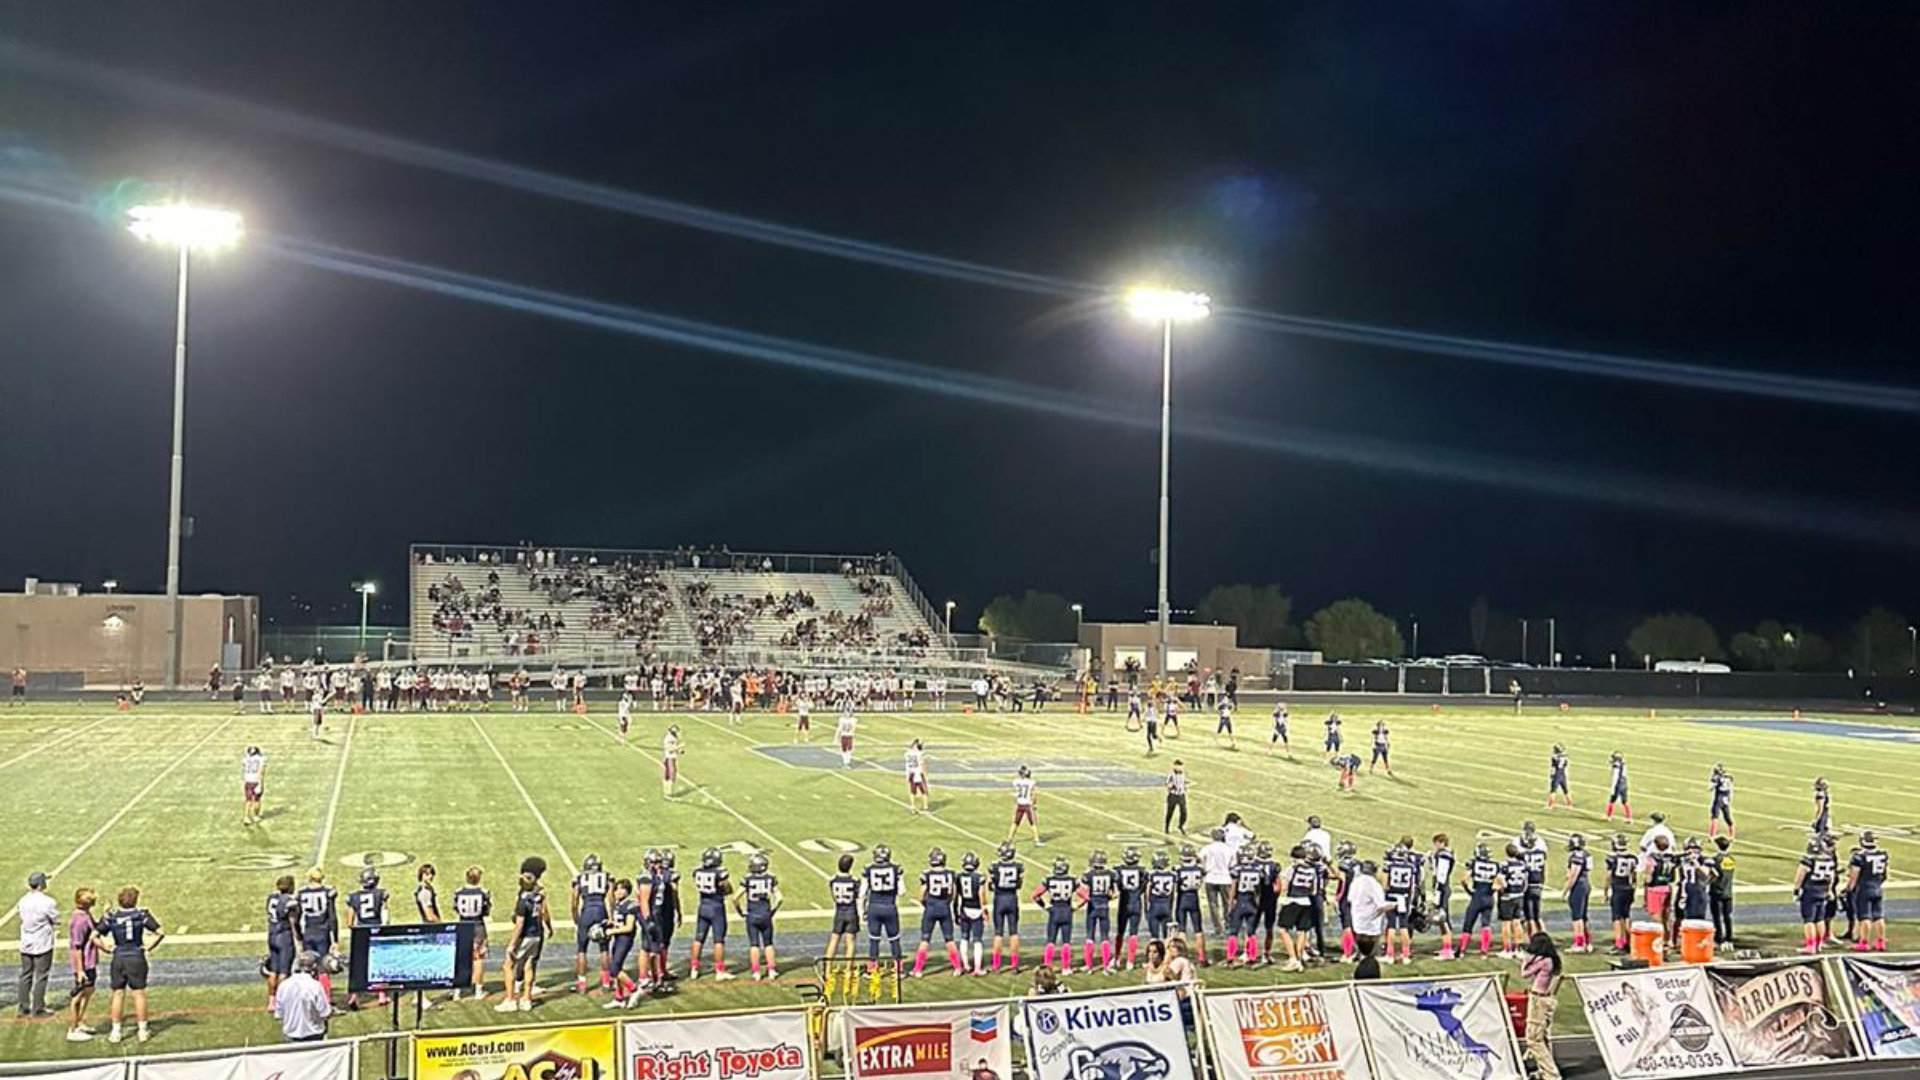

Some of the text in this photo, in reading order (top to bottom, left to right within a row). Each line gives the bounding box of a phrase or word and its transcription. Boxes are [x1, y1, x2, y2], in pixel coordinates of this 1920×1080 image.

[579, 871, 606, 894] 40
[869, 867, 895, 891] 63
[1474, 862, 1498, 882] 52
[1049, 879, 1073, 900] 28
[1152, 875, 1173, 896] 33
[360, 893, 375, 918] 2
[1065, 1000, 1173, 1031] Kiwanis
[1233, 994, 1328, 1029] WESTERN
[1607, 1013, 1622, 1027] is
[1615, 1026, 1640, 1047] Full
[633, 1042, 804, 1080] Right Toyota
